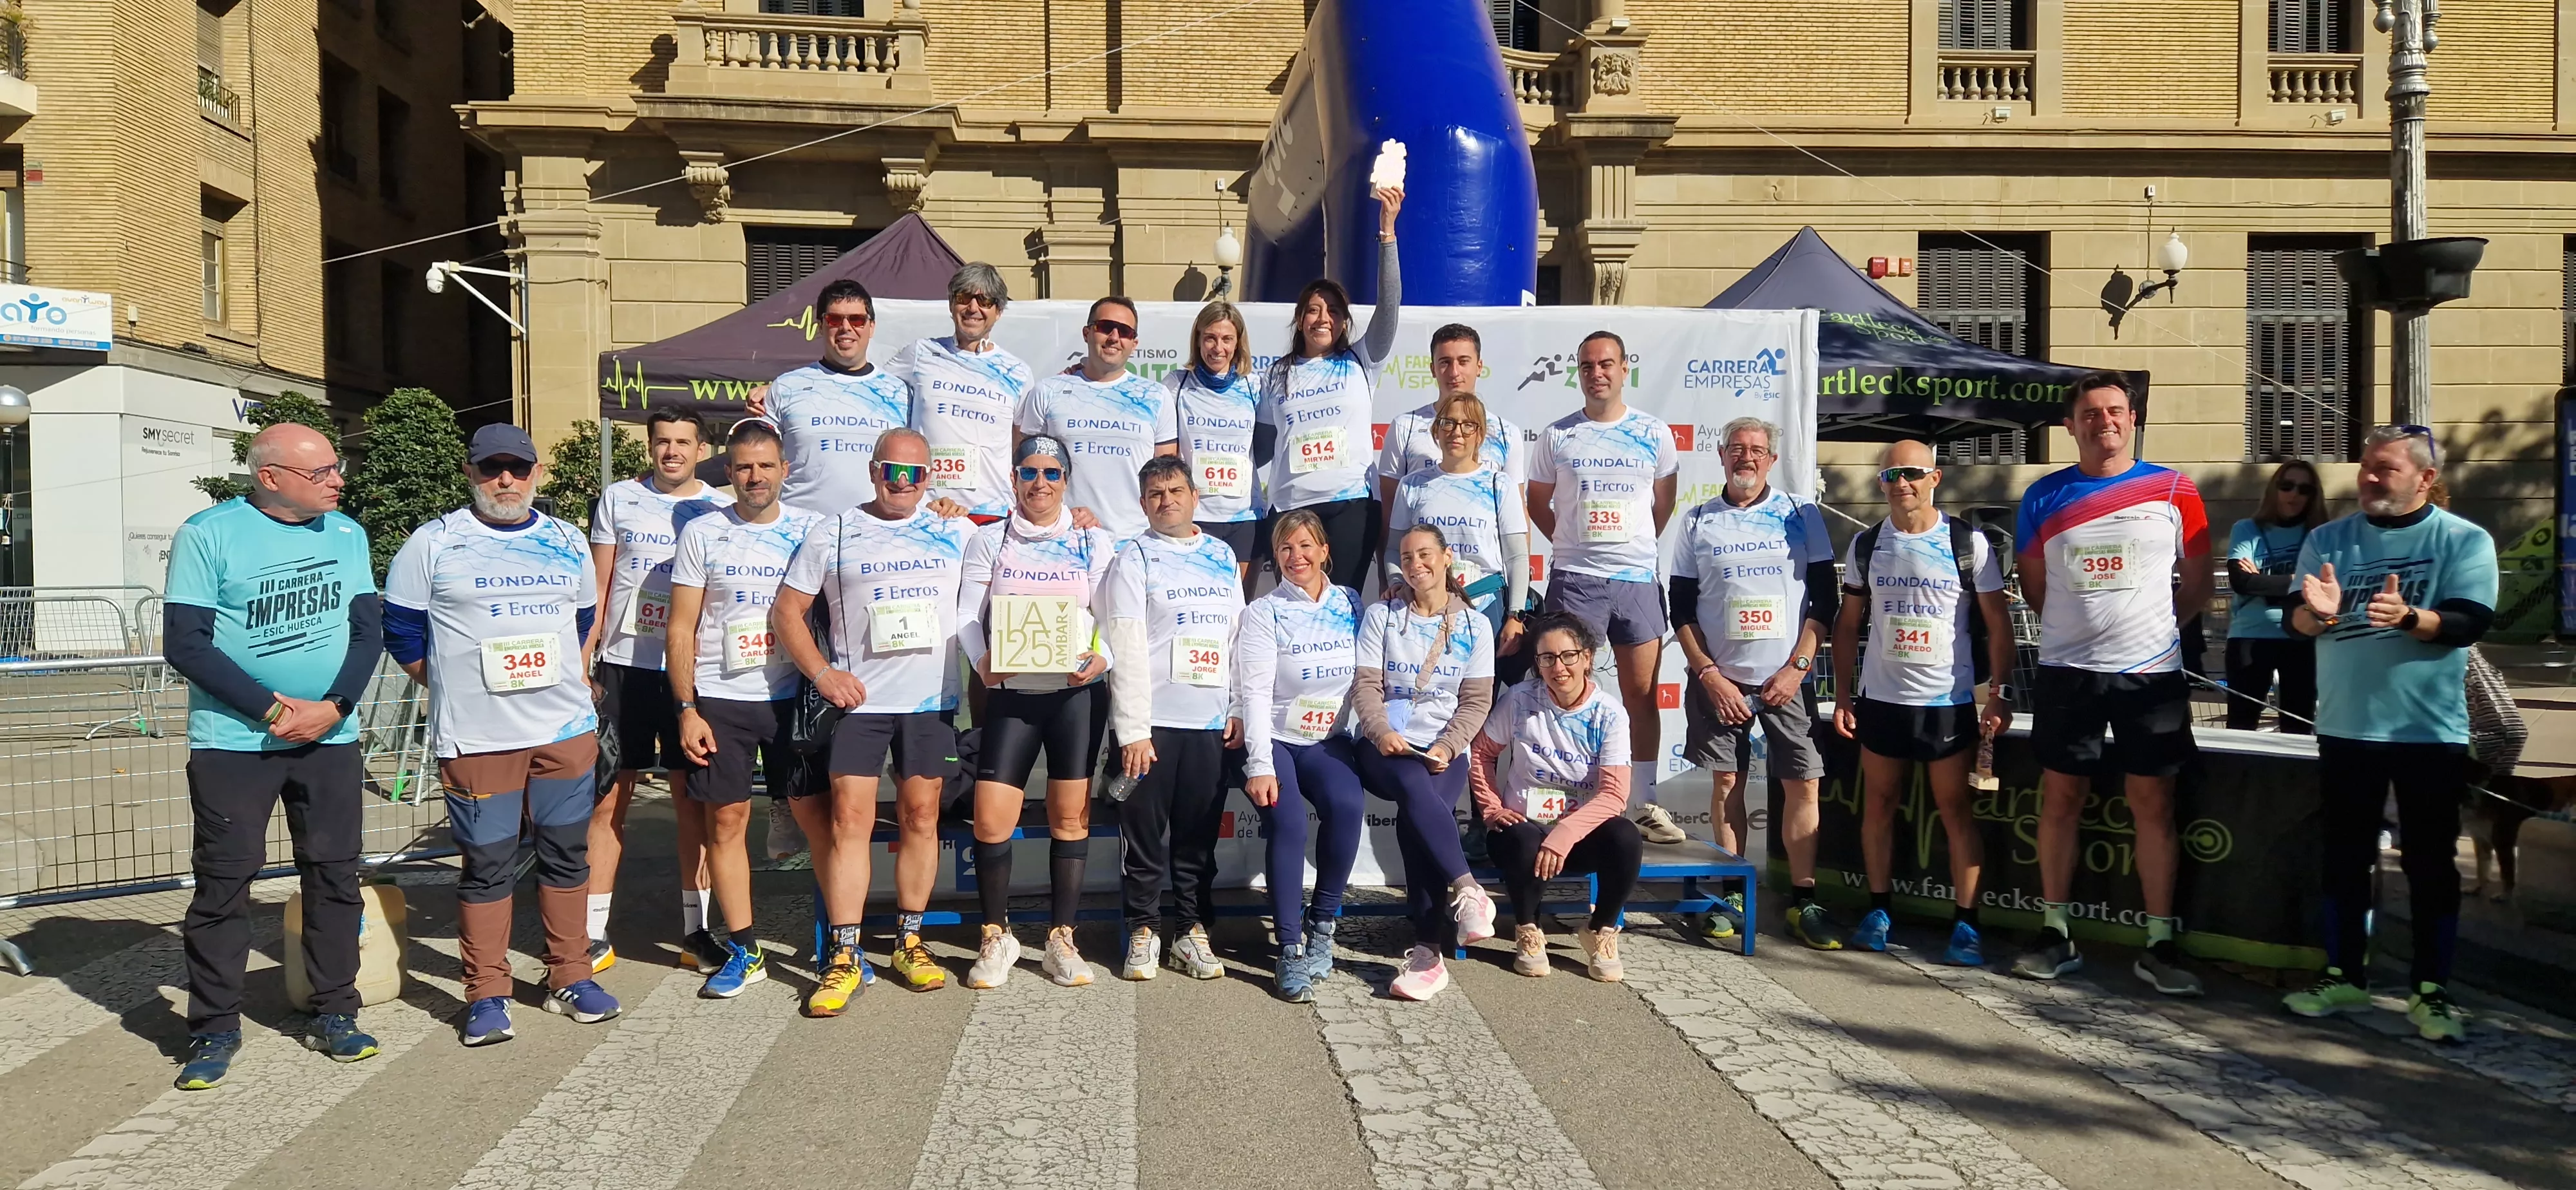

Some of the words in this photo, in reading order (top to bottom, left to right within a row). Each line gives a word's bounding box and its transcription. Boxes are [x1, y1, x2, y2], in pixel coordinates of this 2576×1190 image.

[31, 325, 64, 334] formando
[1129, 349, 1177, 359] TISMO
[1687, 359, 1770, 373] CARRERA
[1685, 375, 1771, 389] EMPRESAS
[1817, 366, 2076, 406] rtlecksport.com
[933, 380, 1007, 404] BONDALTI
[1278, 381, 1345, 406] BONDALTI
[951, 404, 996, 425] Ercros
[1297, 406, 1341, 422] Ercros
[811, 416, 890, 430] BONDALTI
[1067, 418, 1142, 434] BONDALTI
[1188, 416, 1254, 432] BONDALTI
[834, 439, 873, 453] Ercro
[1088, 441, 1132, 457] Ercros
[1207, 439, 1247, 453] Ercros
[1302, 440, 1335, 456] 614
[1696, 440, 1712, 452] de
[933, 458, 965, 473] 336
[1304, 455, 1334, 463] MIRYAN
[1572, 458, 1645, 469] BONDALTI
[1205, 467, 1237, 480] 616
[1593, 480, 1635, 493] Ercros
[1418, 516, 1487, 530] BONDALTI
[1589, 511, 1621, 524] 339
[625, 532, 678, 547] BONDA
[1446, 543, 1479, 554] rcros
[643, 558, 674, 574] Ercr
[861, 558, 946, 574] BONDALTI
[2082, 556, 2123, 572] 398
[726, 565, 786, 578] BONDA
[1002, 568, 1081, 581] BONDALTI
[1736, 565, 1783, 578] Ercros
[260, 578, 275, 596] III
[278, 572, 324, 590] CARRERA
[475, 574, 573, 589] BONDALTI
[1876, 576, 1954, 590] BONDALTI
[889, 585, 939, 600] Ercros
[1166, 587, 1233, 600] BONDALTI
[245, 581, 341, 630] EMPRESAS
[509, 600, 560, 617] Ercros
[641, 603, 666, 620] 61
[1897, 600, 1943, 616] Ercros
[637, 618, 667, 628] ALBER
[899, 616, 908, 630] 1
[1191, 610, 1228, 625] Ercros
[1739, 610, 1772, 623] 350
[263, 624, 285, 638] ESIC
[287, 617, 323, 634] HUESCA
[511, 638, 544, 647] CARRERA
[737, 632, 775, 650] 340
[1056, 613, 1068, 668] AMBAR
[1895, 628, 1929, 645] 341
[741, 648, 775, 657] CARLOS
[1893, 644, 1932, 652] ALFREDO
[503, 652, 545, 670] 348
[1189, 649, 1219, 666] 349
[1316, 665, 1356, 679] Ercros
[1387, 660, 1461, 677] BONALTI
[510, 679, 526, 688] 8K
[1302, 710, 1335, 724] 413
[1550, 771, 1594, 790] Ercros
[1542, 797, 1579, 812] 412
[1367, 814, 1398, 827] iber
[1237, 826, 1253, 838] de
